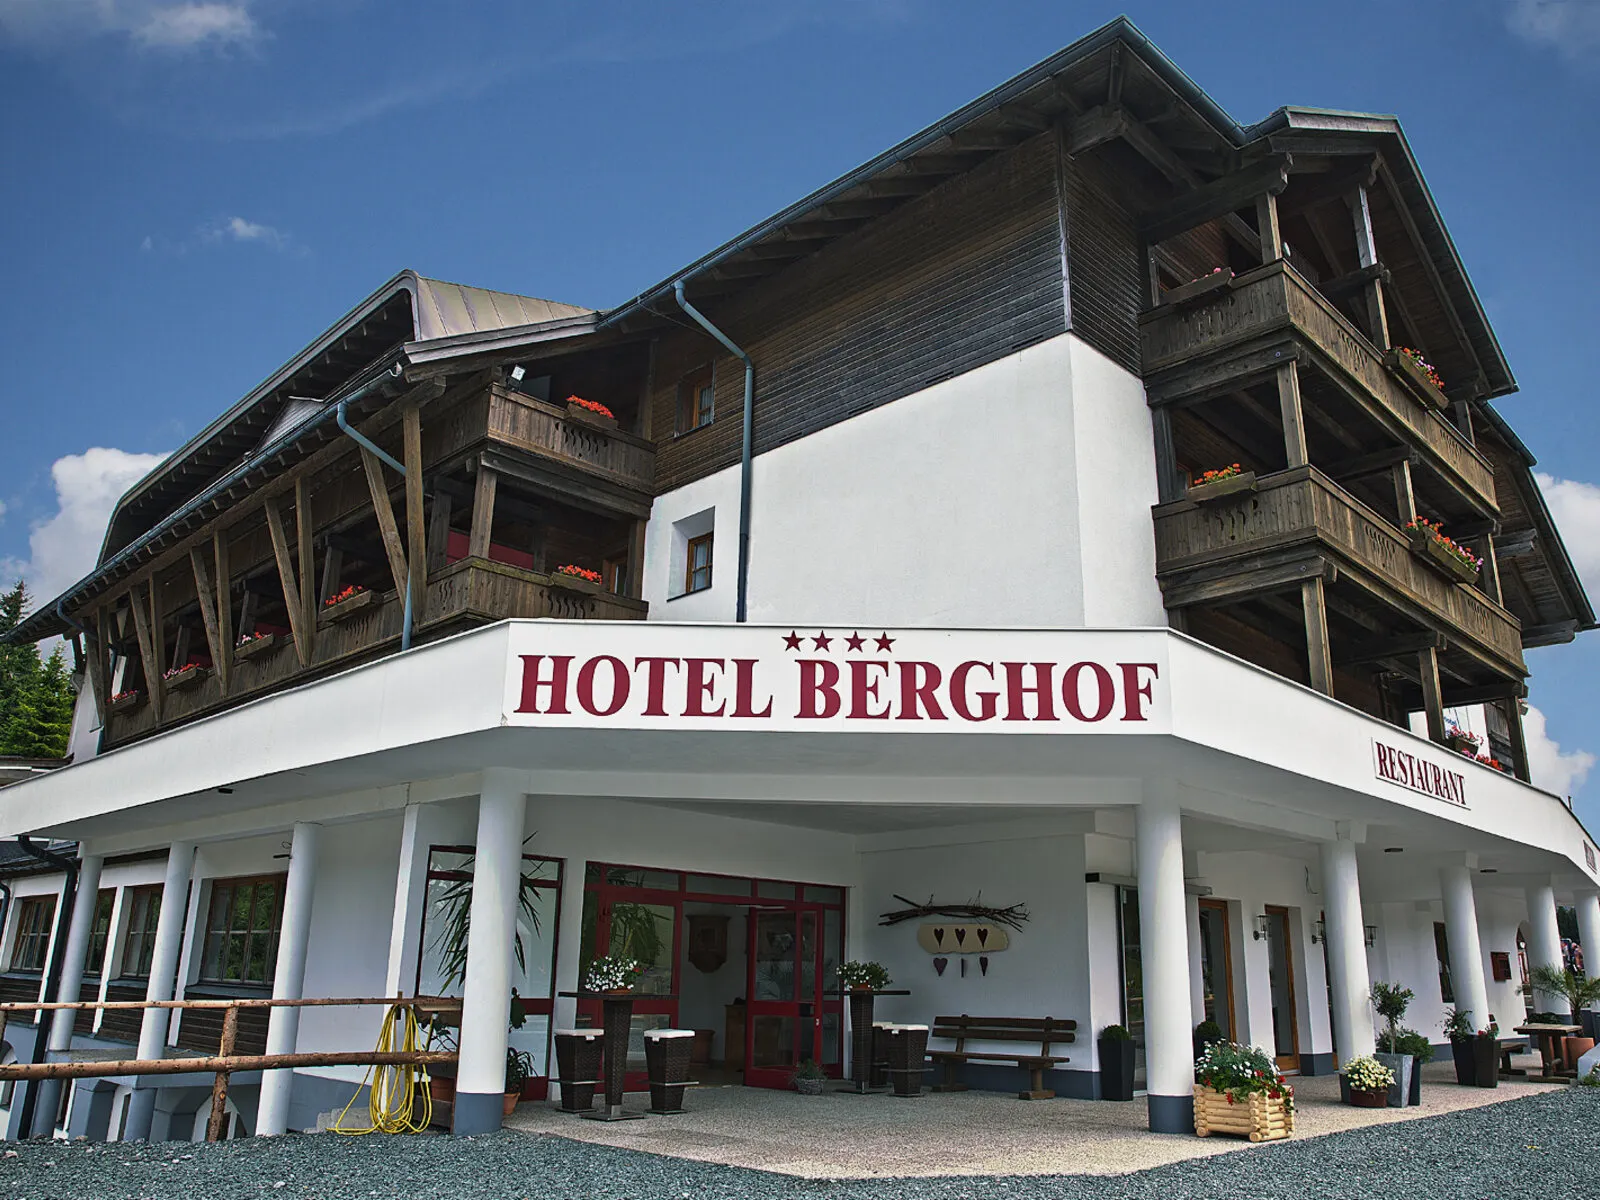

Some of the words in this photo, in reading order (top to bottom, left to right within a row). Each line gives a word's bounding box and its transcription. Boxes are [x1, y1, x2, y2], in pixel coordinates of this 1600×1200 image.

[513, 654, 774, 718] HOTEL
[794, 658, 1160, 723] BERGHOF
[1375, 741, 1467, 806] RESTAURANT
